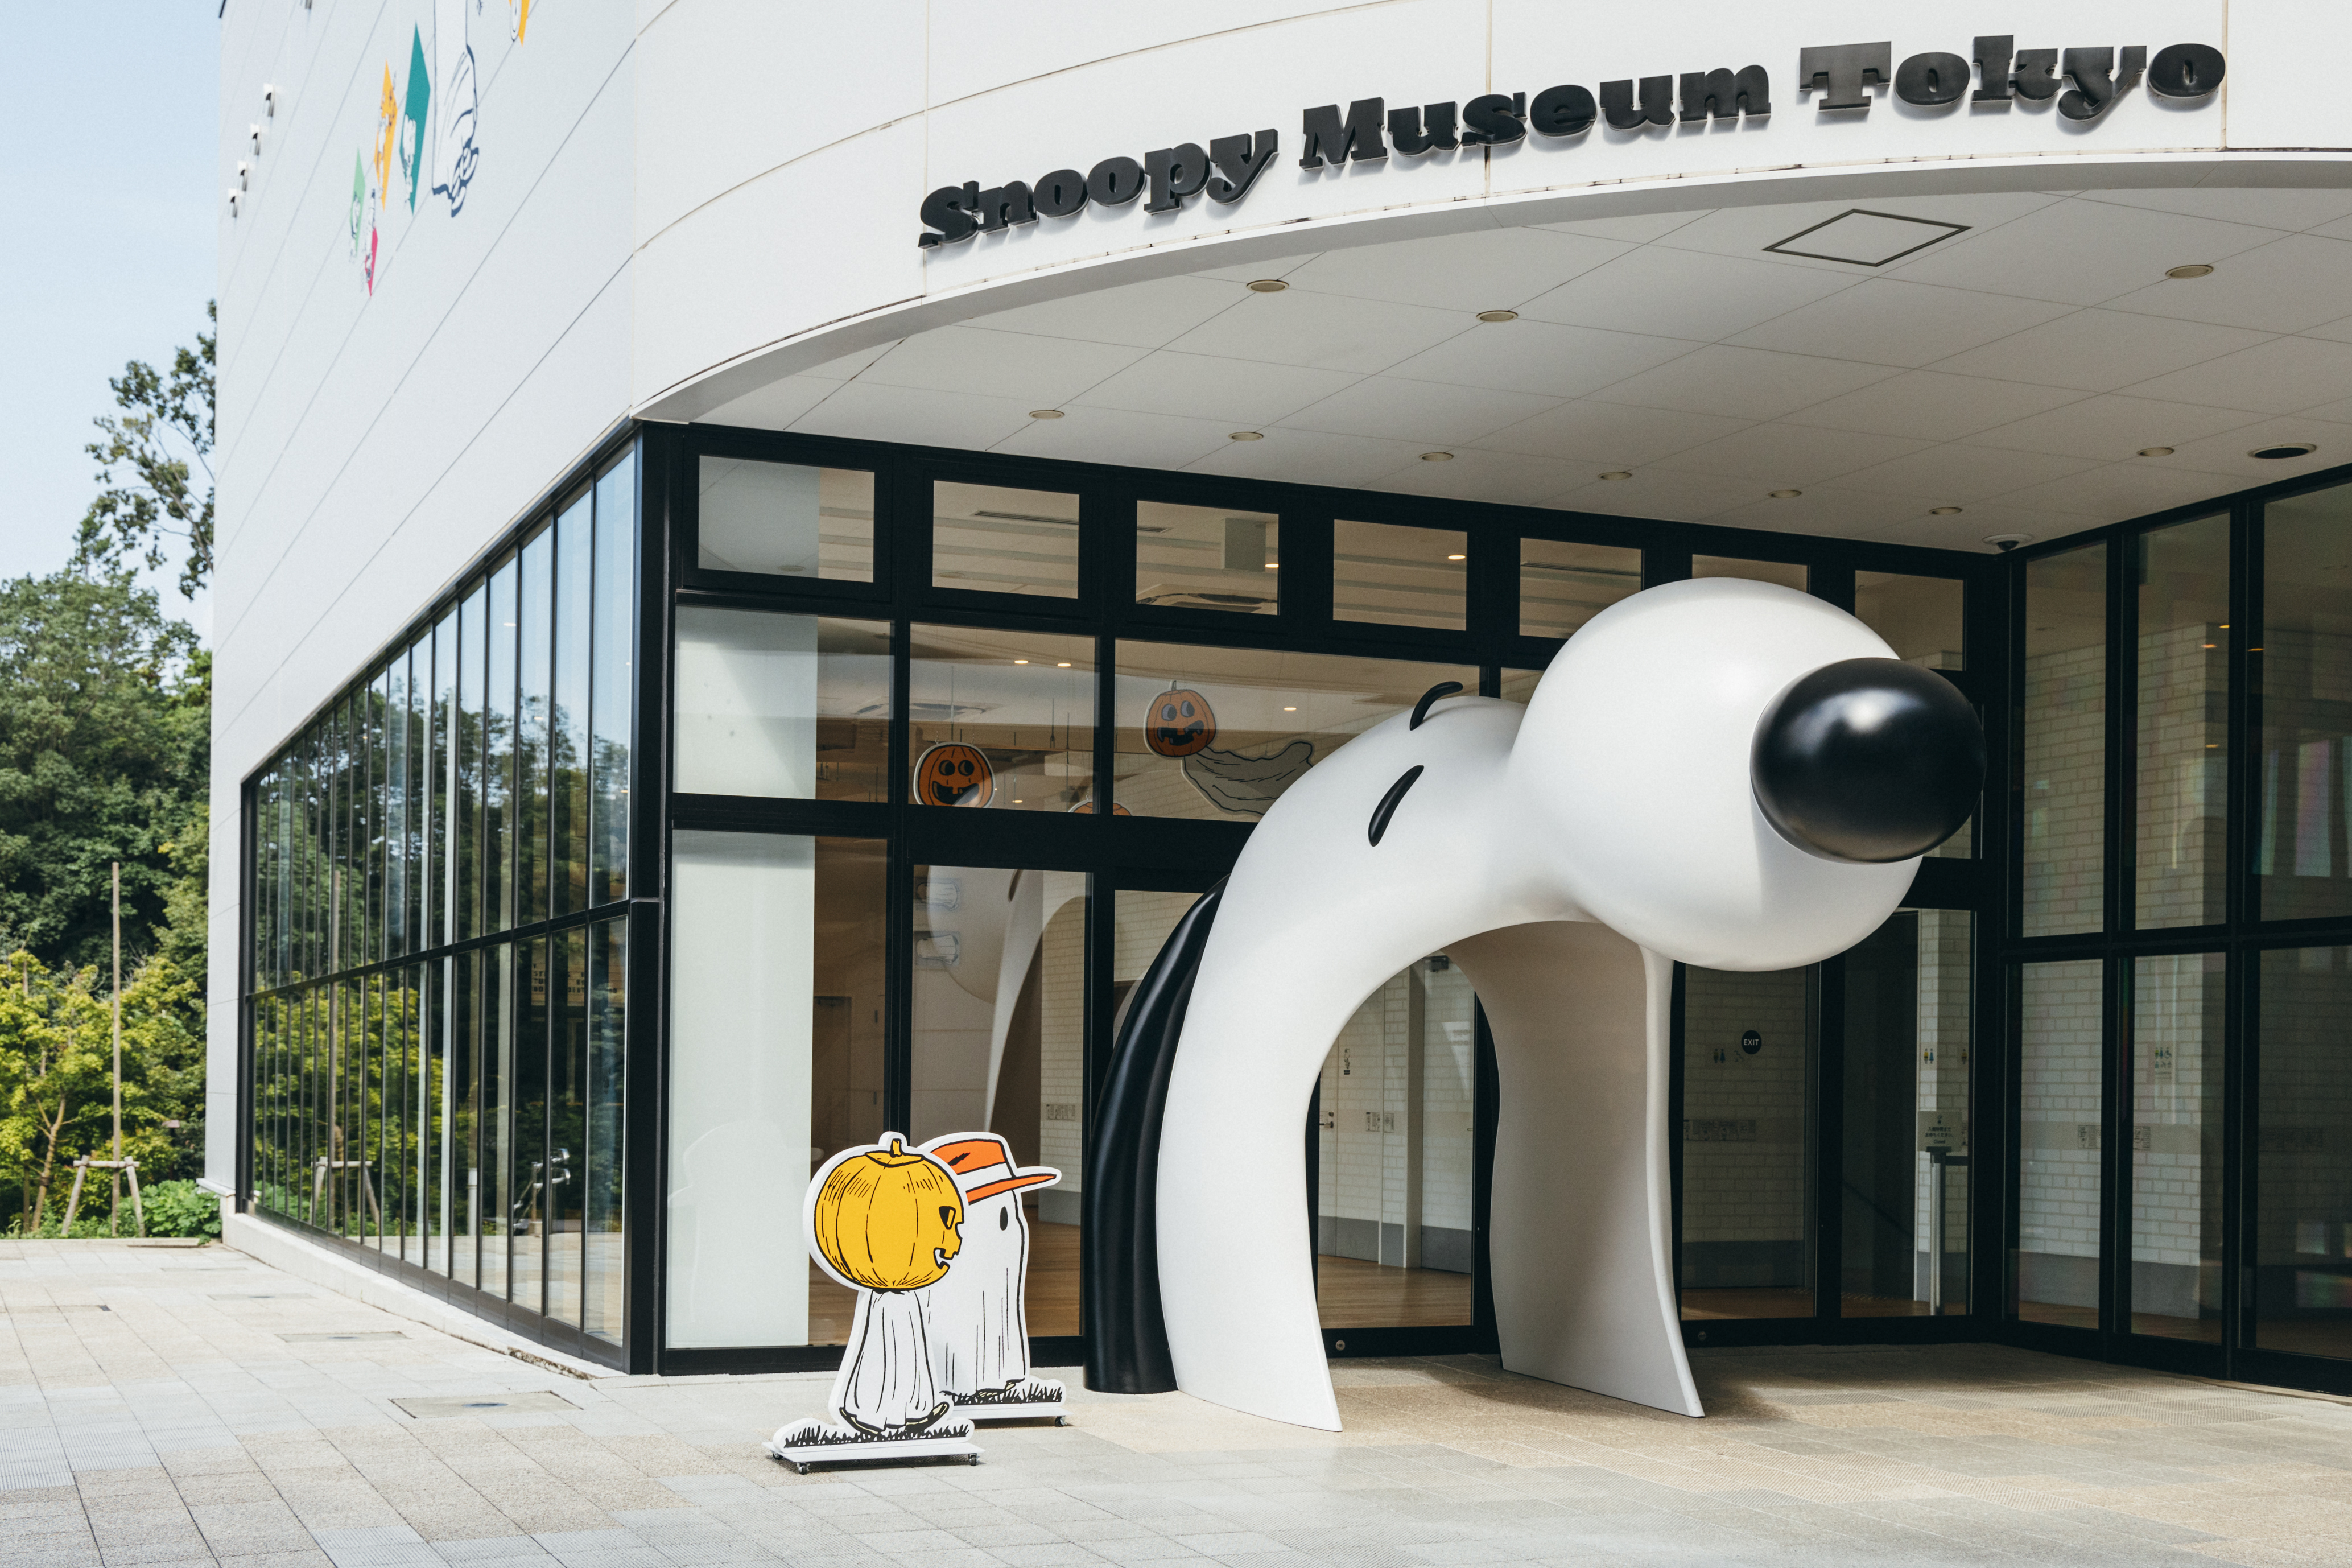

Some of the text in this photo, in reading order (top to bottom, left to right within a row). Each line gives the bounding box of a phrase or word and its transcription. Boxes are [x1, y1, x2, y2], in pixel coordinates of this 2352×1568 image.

[918, 34, 2227, 249] Snoopy Museum Tokyo
